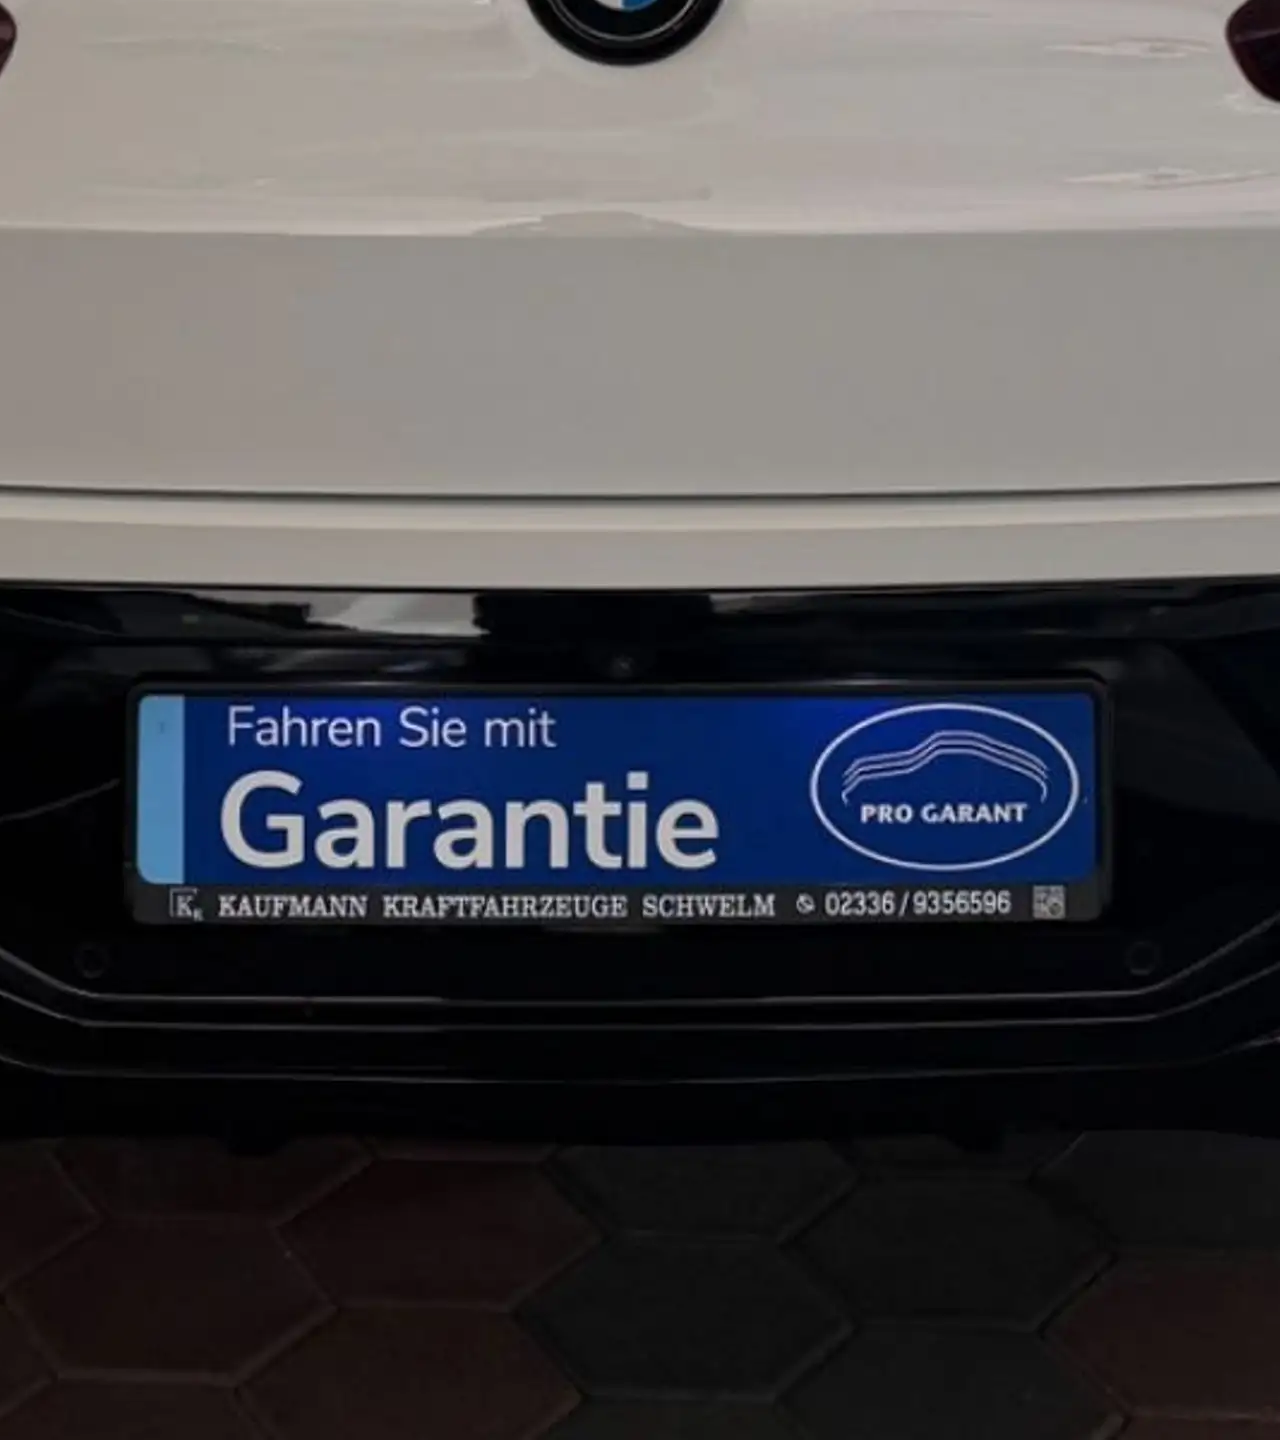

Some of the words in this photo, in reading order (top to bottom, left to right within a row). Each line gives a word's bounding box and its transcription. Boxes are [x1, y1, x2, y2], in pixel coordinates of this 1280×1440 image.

[227, 705, 381, 748] Fahren
[399, 705, 466, 748] Sie
[485, 708, 557, 748] mit
[221, 769, 719, 869] Garantie
[860, 804, 913, 824] PRO
[920, 803, 1028, 824] GARANT
[219, 893, 368, 919] KAUFMANN
[382, 893, 628, 919] KRAFTFAHRZEUGE
[642, 893, 776, 918] SCHWELM
